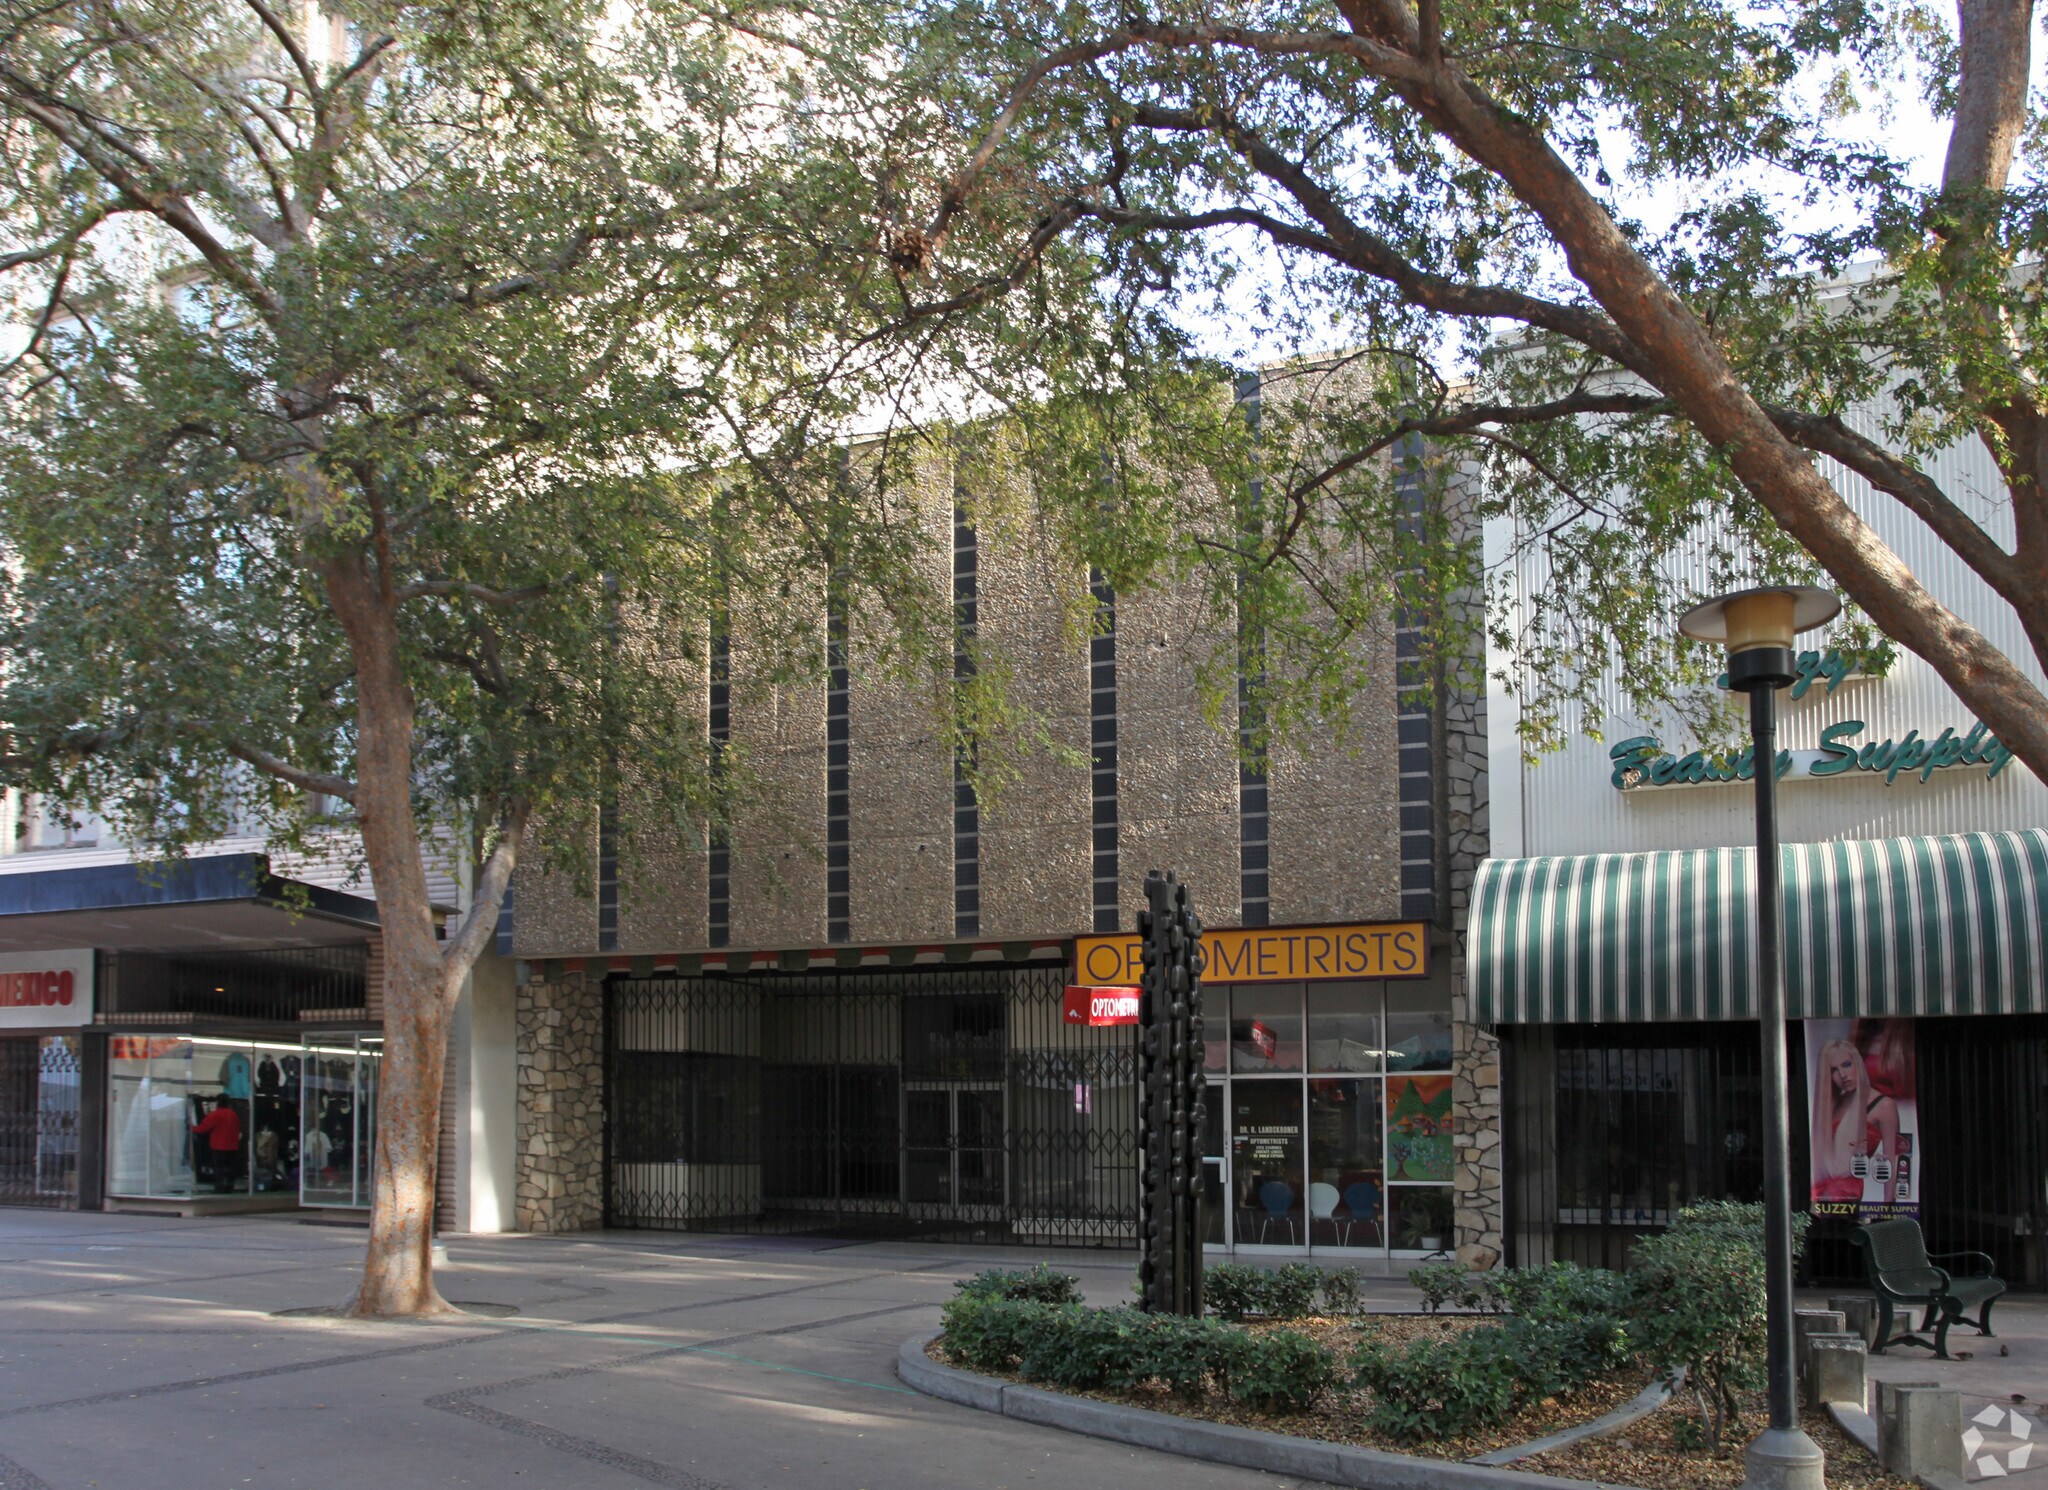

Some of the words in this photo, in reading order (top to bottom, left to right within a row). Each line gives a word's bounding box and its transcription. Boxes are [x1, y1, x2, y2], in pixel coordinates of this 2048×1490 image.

[1086, 931, 1417, 982] OPMETRISTS
[1815, 1203, 1857, 1214] SUZZY
[1860, 1205, 1889, 1213] BEAUTY
